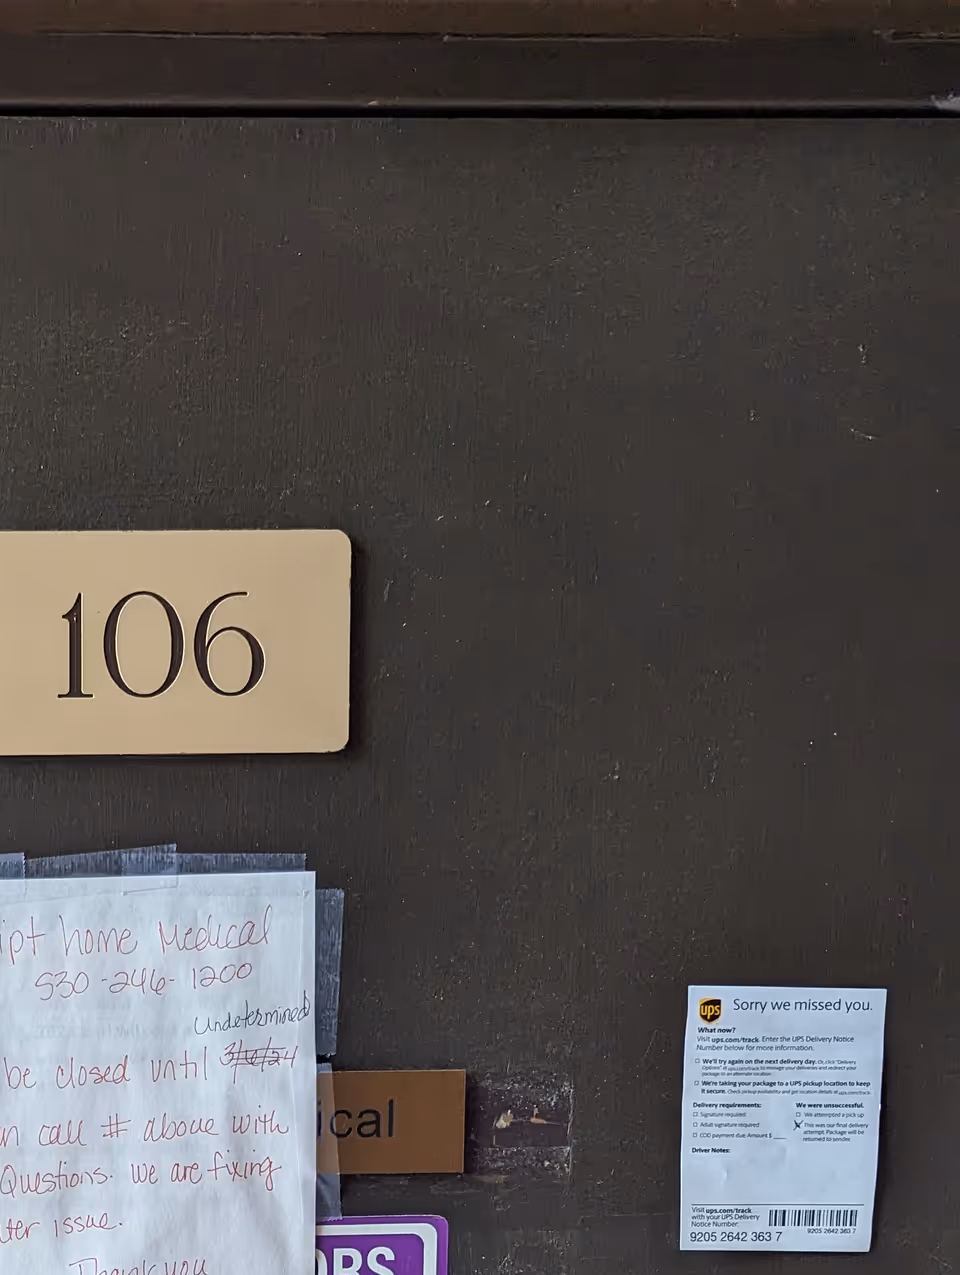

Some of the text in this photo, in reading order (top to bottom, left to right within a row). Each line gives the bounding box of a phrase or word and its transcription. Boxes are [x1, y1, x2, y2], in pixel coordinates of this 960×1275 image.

[58, 590, 266, 698] 106
[58, 914, 138, 957] home
[158, 904, 272, 954] Medical
[700, 1003, 721, 1020] ups
[733, 998, 873, 1014] Sorry we missed you.
[711, 1036, 760, 1044] ups.com/track.
[761, 1035, 779, 1043] Enter
[805, 1035, 832, 1044] Delivery
[832, 1035, 855, 1043] Notice
[3, 1056, 37, 1089] be
[55, 1054, 130, 1089] closed
[150, 1046, 207, 1082] until
[718, 1058, 727, 1066] try
[727, 1058, 744, 1066] again
[804, 1058, 817, 1066] day.
[38, 1119, 87, 1146] call
[101, 1113, 131, 1138] #
[143, 1114, 219, 1142] above
[232, 1105, 289, 1135] with
[170, 1161, 203, 1184] are
[207, 1149, 282, 1192] fixing
[705, 1207, 752, 1215] ups.com/track
[689, 1231, 783, 1242] 9205 2642 363 7
